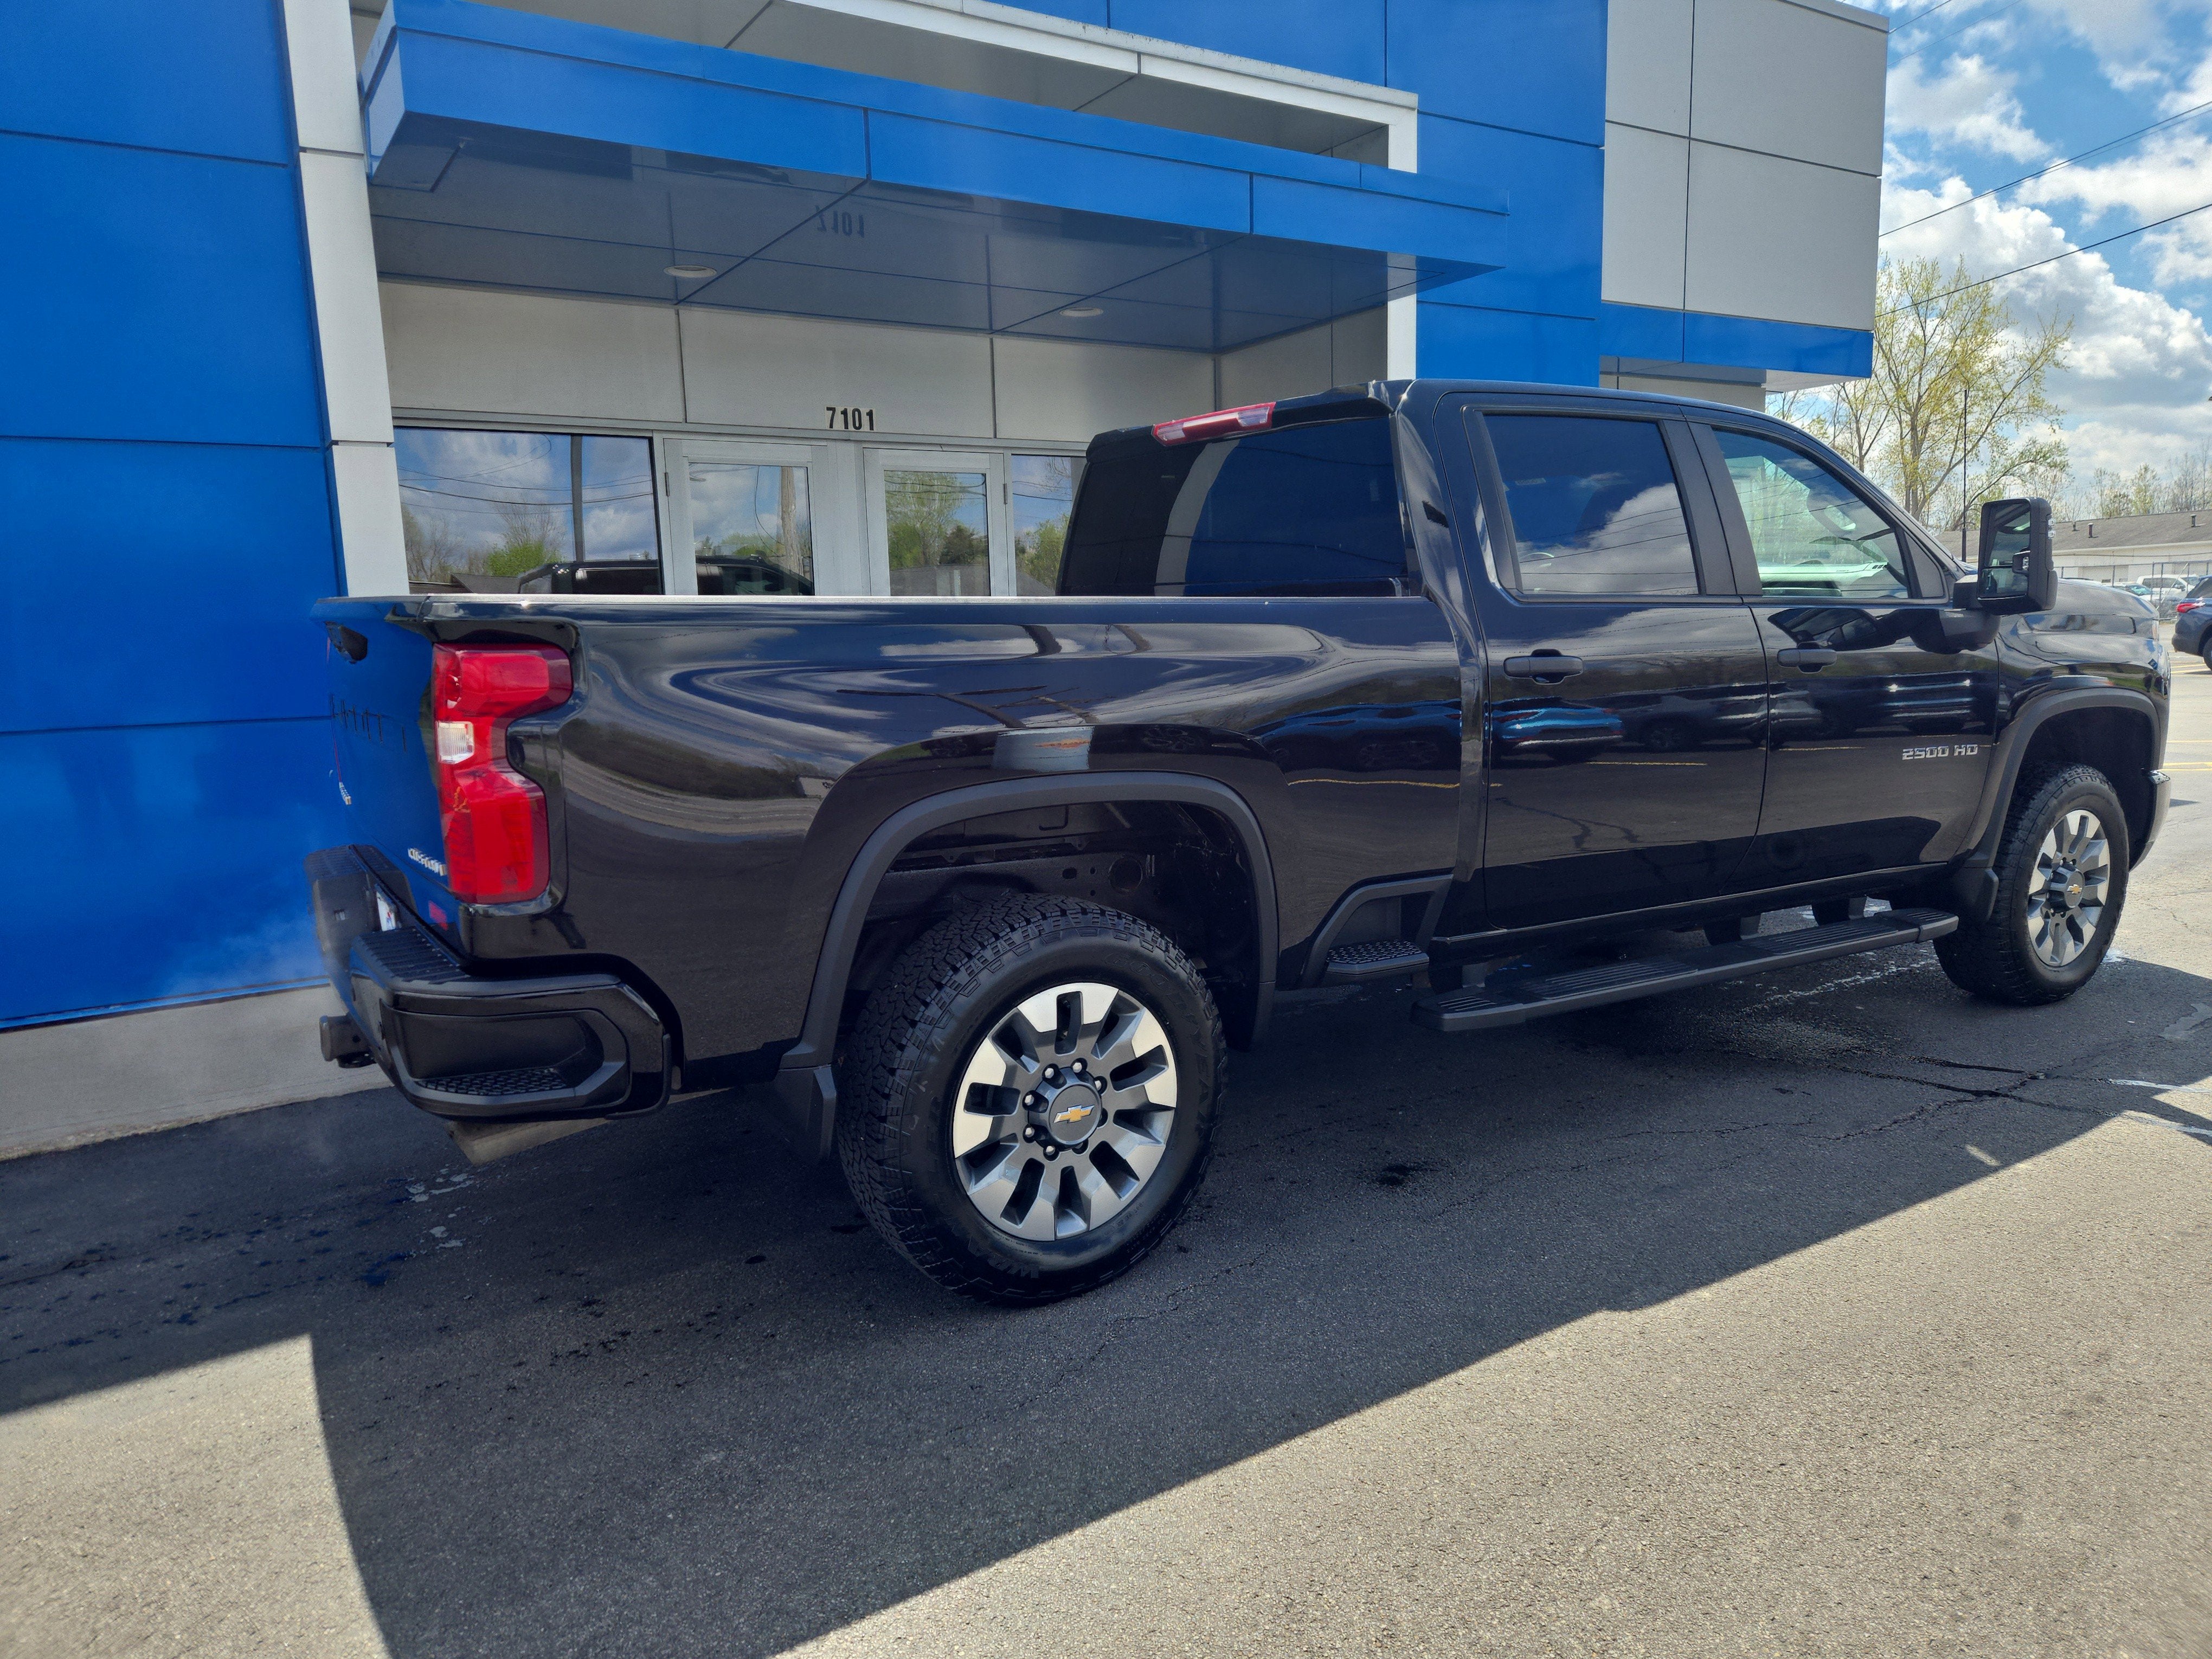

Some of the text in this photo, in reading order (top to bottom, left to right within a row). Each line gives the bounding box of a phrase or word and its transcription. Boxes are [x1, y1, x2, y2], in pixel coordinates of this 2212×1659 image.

[826, 406, 874, 431] 7101
[1902, 744, 1978, 760] 2500 HD
[1103, 950, 1212, 1139] GOODYEAR
